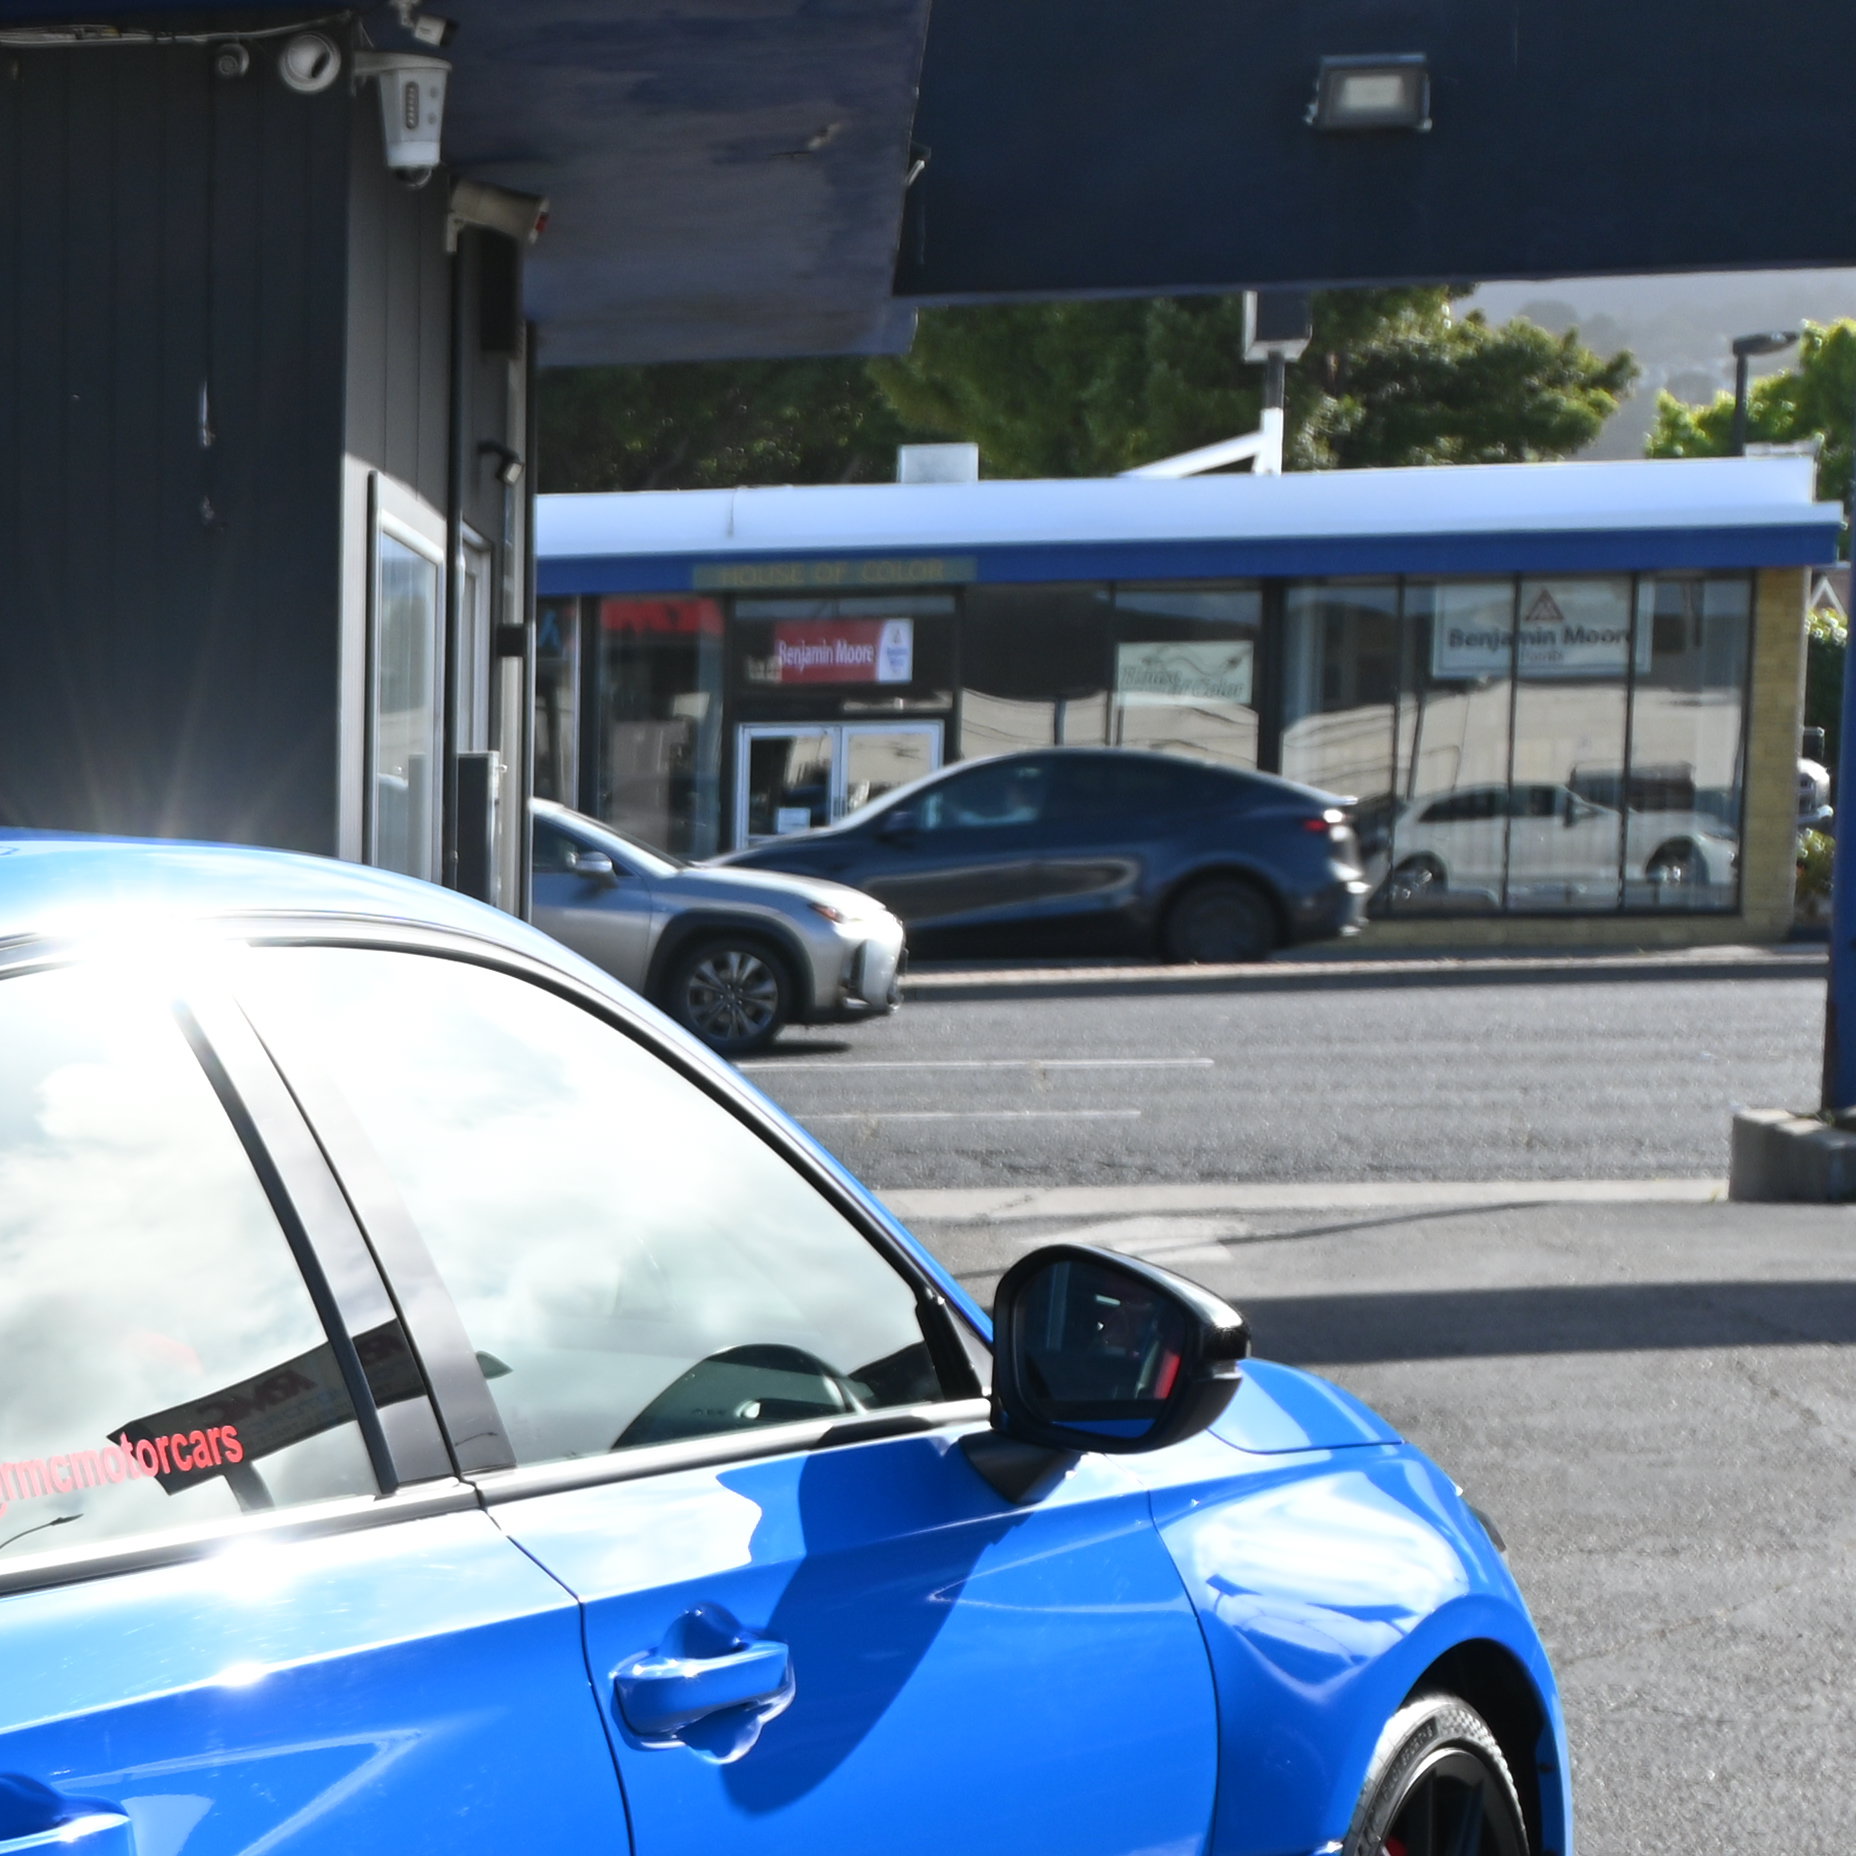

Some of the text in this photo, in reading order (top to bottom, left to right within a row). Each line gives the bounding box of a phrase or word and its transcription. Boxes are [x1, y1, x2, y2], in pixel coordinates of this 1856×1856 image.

[721, 558, 944, 585] HOUSE OF COLOR
[1563, 625, 1631, 646] Moor
[778, 639, 834, 672] Benjamin
[836, 639, 875, 665] Moore
